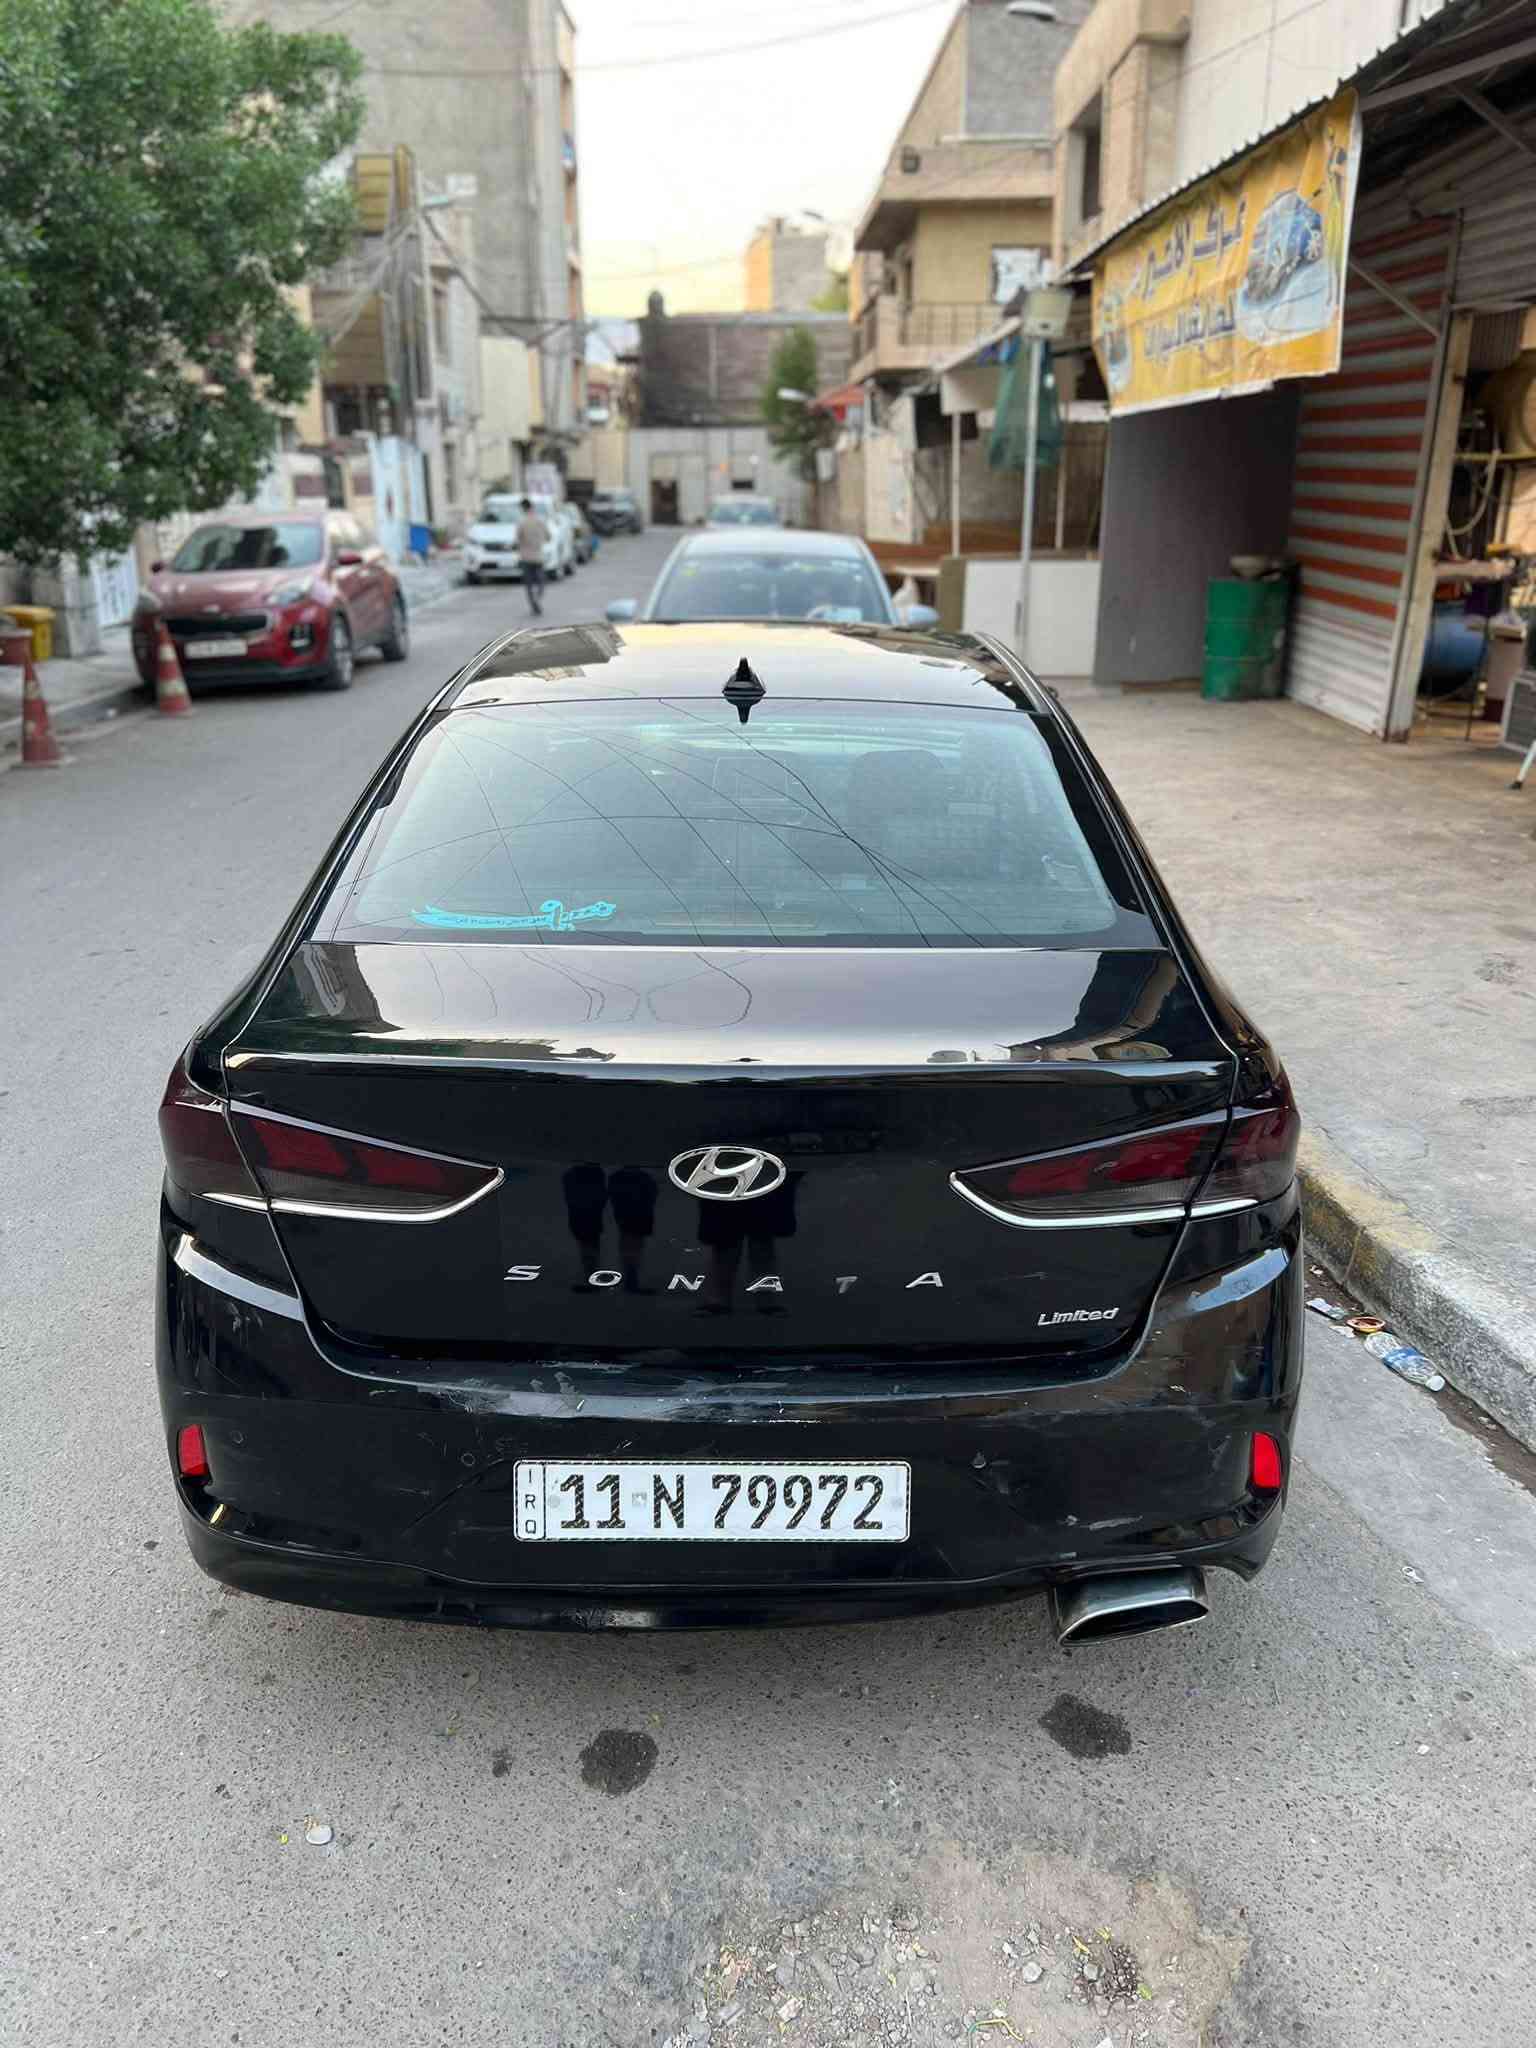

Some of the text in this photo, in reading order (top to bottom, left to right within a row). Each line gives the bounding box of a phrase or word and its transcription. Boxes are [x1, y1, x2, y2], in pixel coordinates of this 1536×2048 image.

[504, 1264, 944, 1293] SONATA
[1037, 1307, 1120, 1327] Limited
[560, 1474, 884, 1530] 11 N 79972
